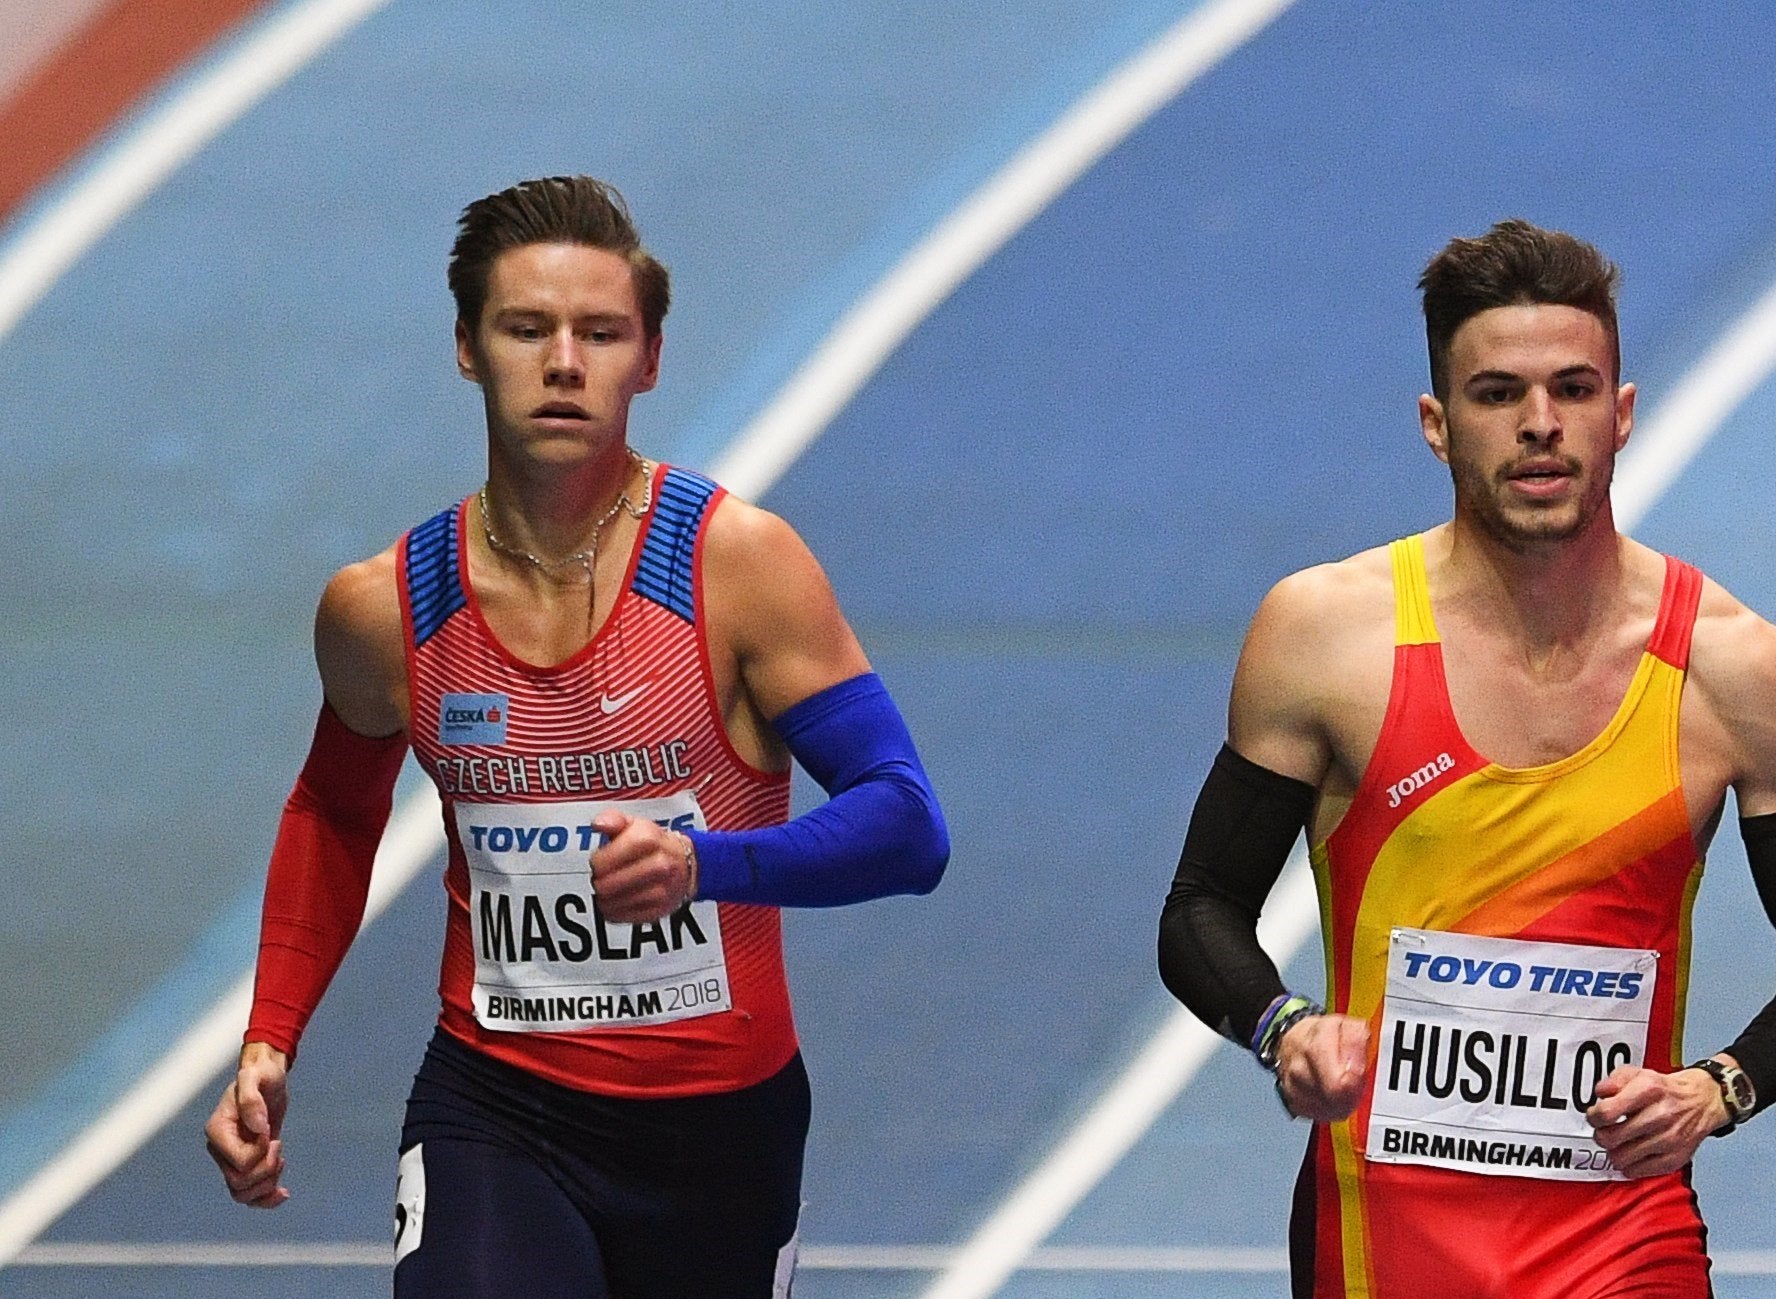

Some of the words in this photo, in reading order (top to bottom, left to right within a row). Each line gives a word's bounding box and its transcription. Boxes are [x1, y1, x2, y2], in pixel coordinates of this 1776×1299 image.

[436, 757, 529, 794] CZECH
[539, 741, 691, 795] REPUBLIC
[469, 826, 568, 853] TOYO
[1404, 952, 1522, 990] TOYO
[1529, 965, 1645, 1000] TIRES
[487, 991, 663, 1022] BIRMINGHAM
[667, 978, 721, 1012] 2018
[1382, 1127, 1573, 1170] BIRMINGHAM
[1574, 1149, 1624, 1172] 20
